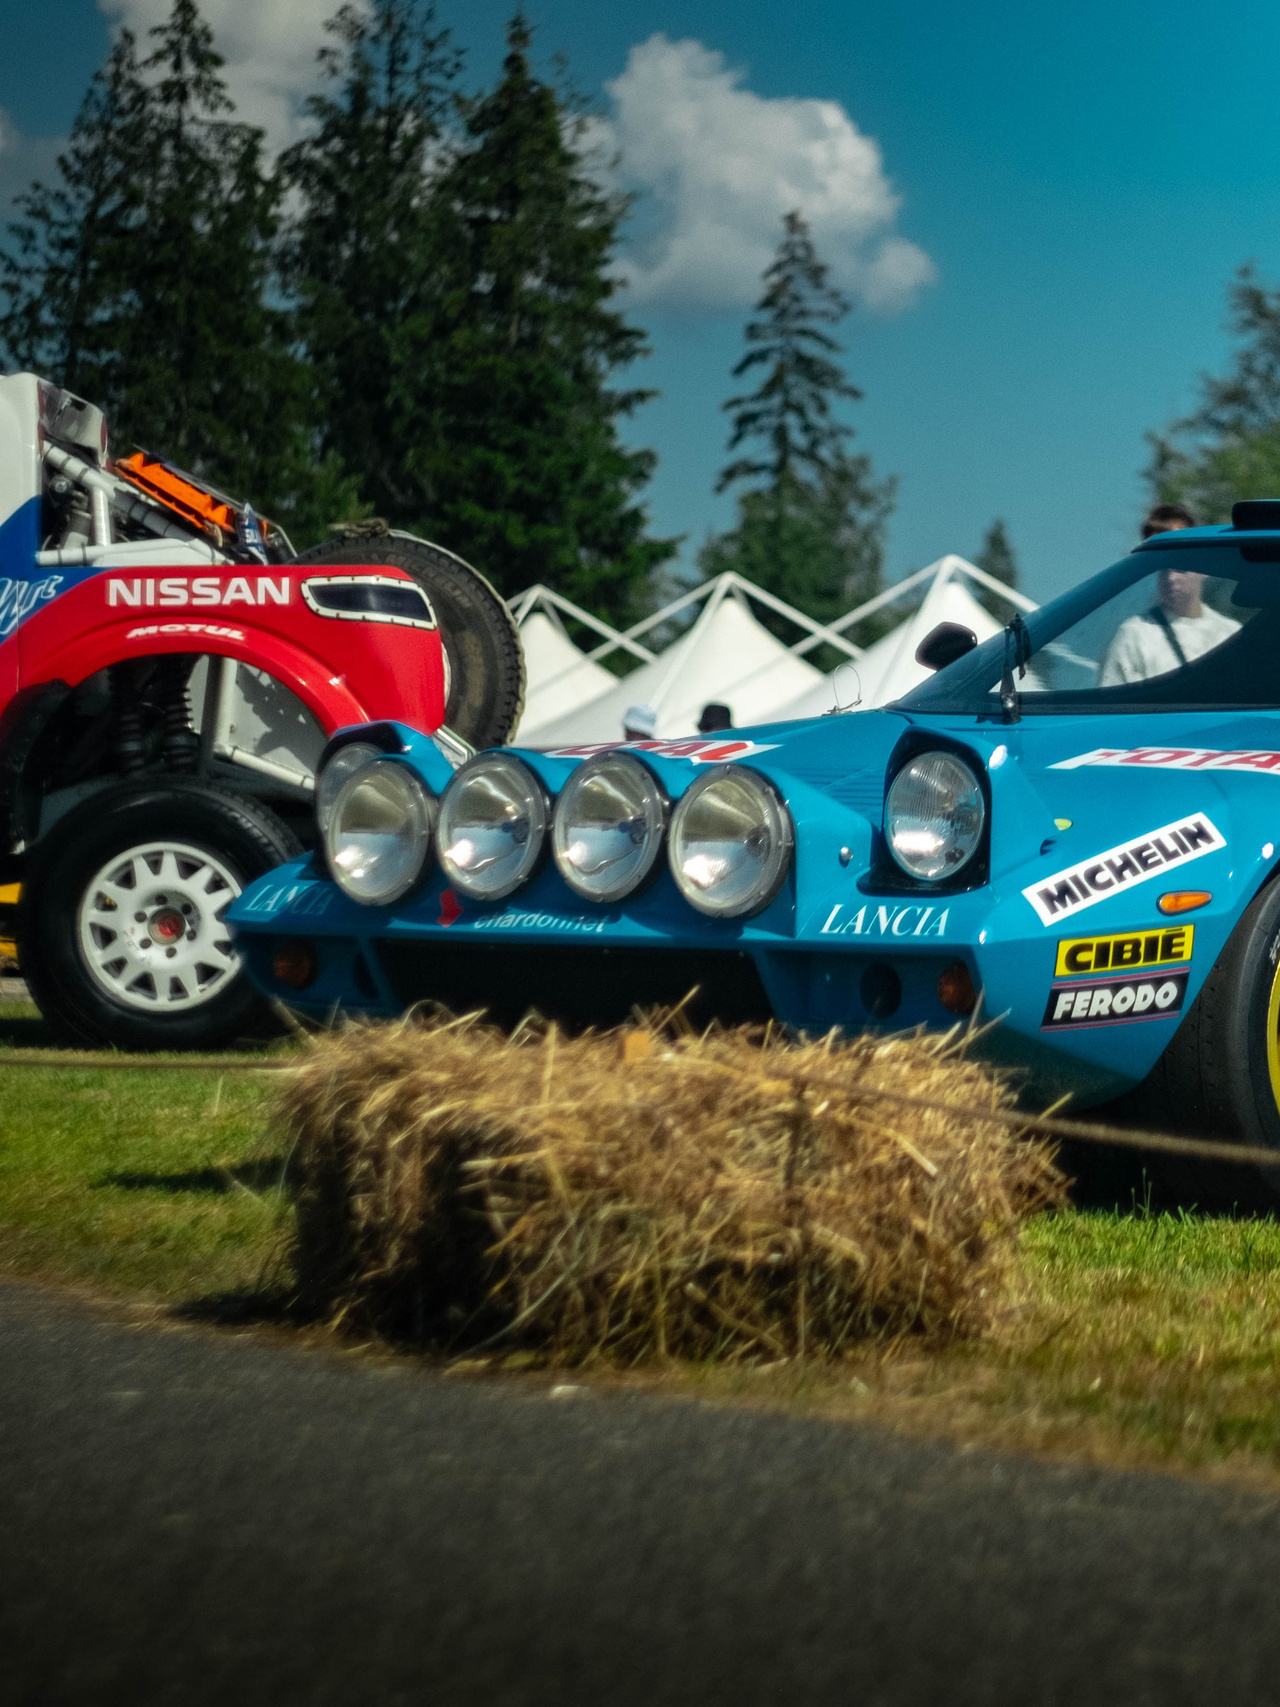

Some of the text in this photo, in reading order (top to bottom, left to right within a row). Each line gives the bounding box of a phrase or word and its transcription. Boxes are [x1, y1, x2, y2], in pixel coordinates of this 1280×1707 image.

[108, 577, 290, 607] NISSAN
[125, 623, 245, 641] MOTUL
[555, 741, 748, 761] OTAL
[1036, 821, 1216, 915] MICHELIN
[243, 884, 335, 915] LANCIA
[819, 903, 951, 937] LANCIA
[1052, 981, 1178, 1021] FERODO
